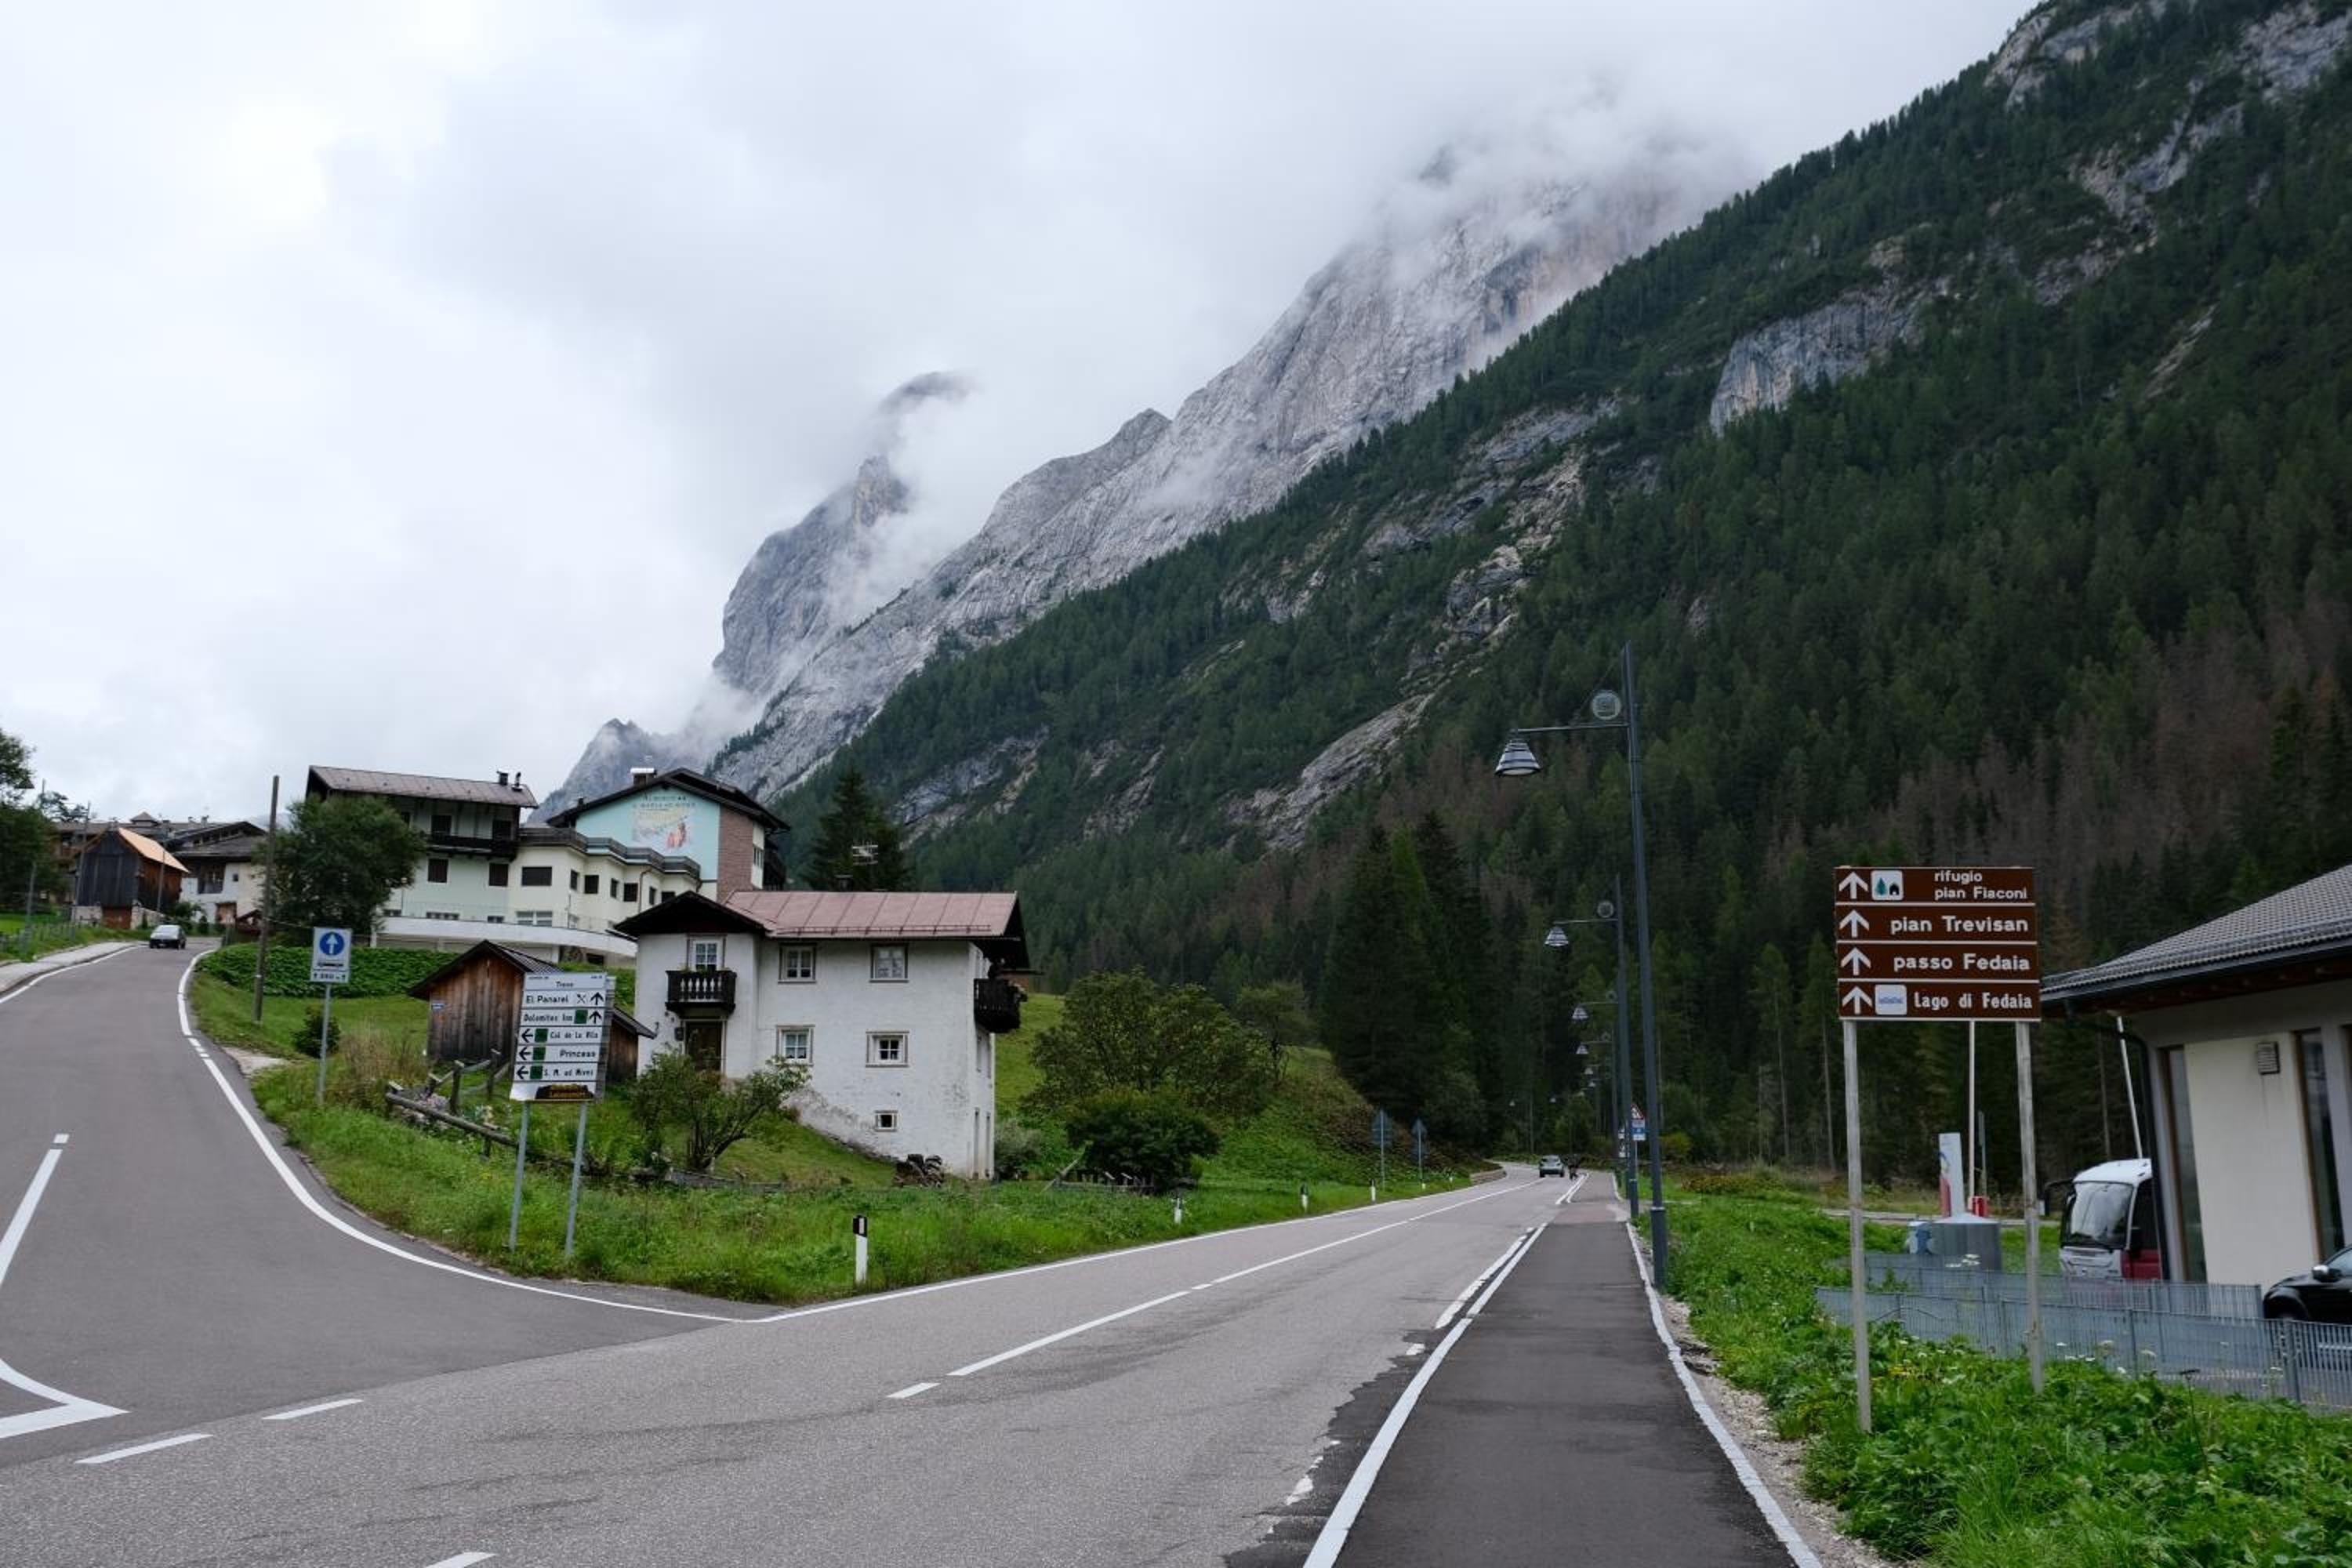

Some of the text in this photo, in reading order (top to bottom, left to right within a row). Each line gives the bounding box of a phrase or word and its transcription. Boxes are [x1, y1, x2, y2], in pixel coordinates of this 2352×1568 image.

[1934, 870, 1983, 884] rifugio
[1934, 886, 2027, 901] pian Fiaconi
[1890, 915, 2028, 935] pian Trevisan
[1893, 953, 2030, 972] passo Fedaia
[1914, 992, 2032, 1010] Lago di Fedaia
